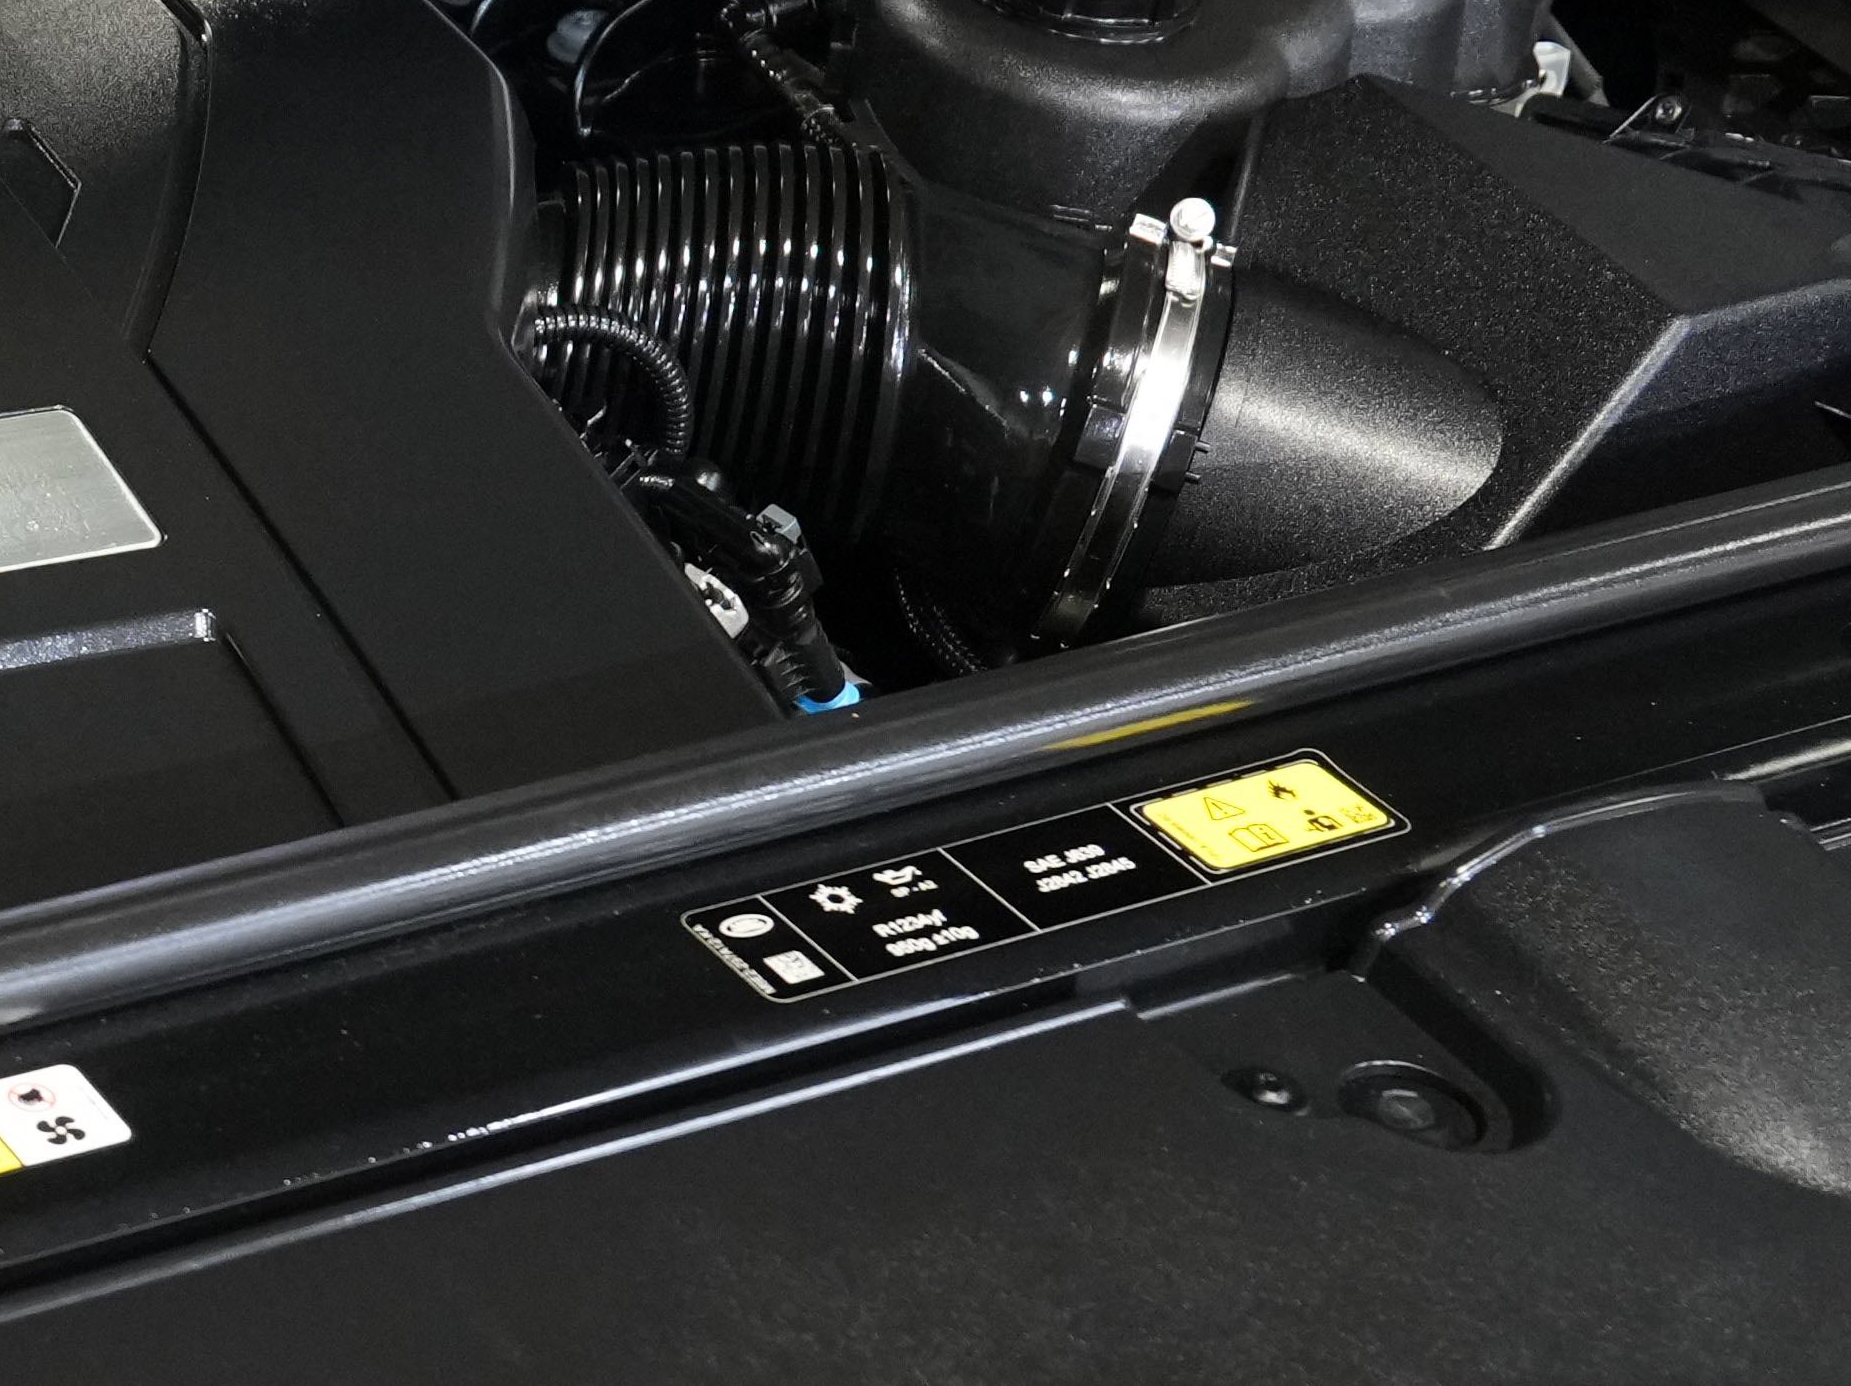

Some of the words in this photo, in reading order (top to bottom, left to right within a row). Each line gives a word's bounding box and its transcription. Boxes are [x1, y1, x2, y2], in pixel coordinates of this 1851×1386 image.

[1023, 854, 1067, 874] SAE
[1063, 844, 1106, 864] J639
[1035, 870, 1089, 893] J2842
[1084, 856, 1137, 880] J2845
[872, 908, 948, 938] R1234yf
